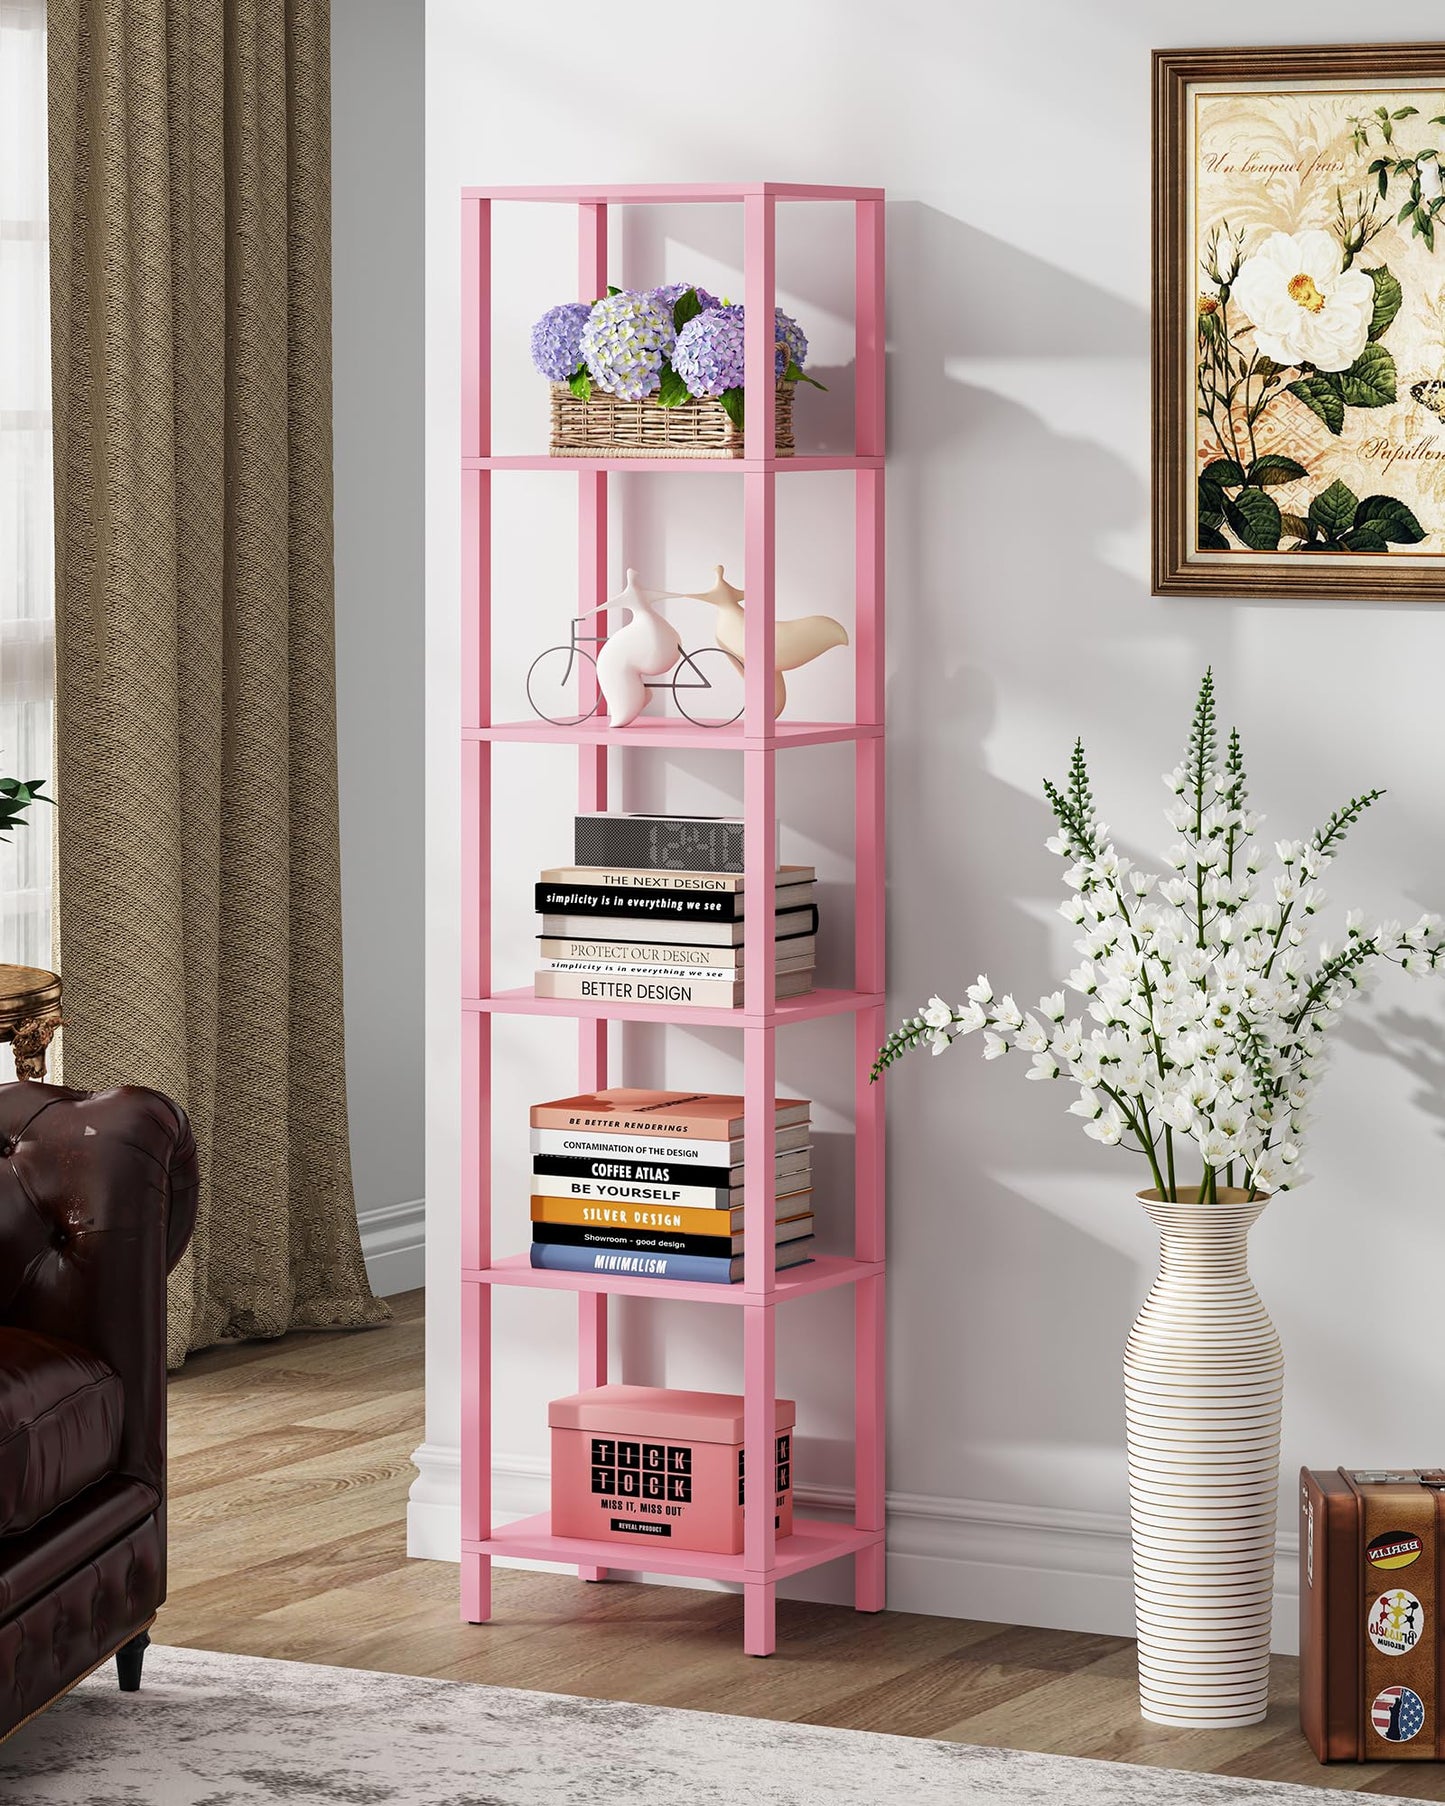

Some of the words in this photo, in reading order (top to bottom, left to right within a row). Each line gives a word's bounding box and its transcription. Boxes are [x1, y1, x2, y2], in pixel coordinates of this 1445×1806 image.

[1202, 152, 1234, 173] Un
[602, 874, 630, 886] THE
[633, 876, 669, 888] NEXT
[673, 878, 726, 890] DESIGN
[546, 892, 599, 907] simplicity
[601, 894, 610, 906] is
[613, 895, 624, 907] in
[627, 897, 684, 912] everything
[686, 900, 701, 911] we
[703, 901, 722, 912] see
[570, 943, 629, 960] PROTECT
[630, 947, 661, 962] OUR
[662, 949, 711, 964] DESIGN
[551, 961, 602, 973] simplicity
[605, 964, 614, 972] is
[617, 965, 627, 973] in
[630, 966, 685, 977] everything
[581, 980, 632, 999] BETTER
[637, 984, 692, 1001] DESIGN
[569, 1117, 581, 1125] BE
[584, 1119, 621, 1128] BETTER
[624, 1121, 689, 1132] RENDERINGS
[563, 1140, 634, 1154] CONTAMINATION
[636, 1145, 647, 1155] OF
[648, 1146, 665, 1156] THE
[666, 1147, 699, 1158] DESIGN
[591, 1162, 632, 1179] COFFEE
[635, 1165, 670, 1182] ATLAS
[571, 1182, 591, 1195] BE
[596, 1185, 681, 1201] YOURSELF
[583, 1207, 627, 1224] SILVER
[634, 1211, 681, 1227] DESIGN
[584, 1233, 628, 1244] Showroom
[635, 1237, 657, 1248] good
[658, 1239, 686, 1250] design
[594, 1254, 668, 1274] MINIMALISM
[599, 1444, 684, 1470] TICK
[599, 1472, 684, 1497] TOCK
[601, 1499, 623, 1510] MISS
[626, 1501, 637, 1514] IT,
[640, 1503, 662, 1514] MISS
[618, 1522, 638, 1531] REVEAL
[639, 1525, 662, 1533] PRODUCT
